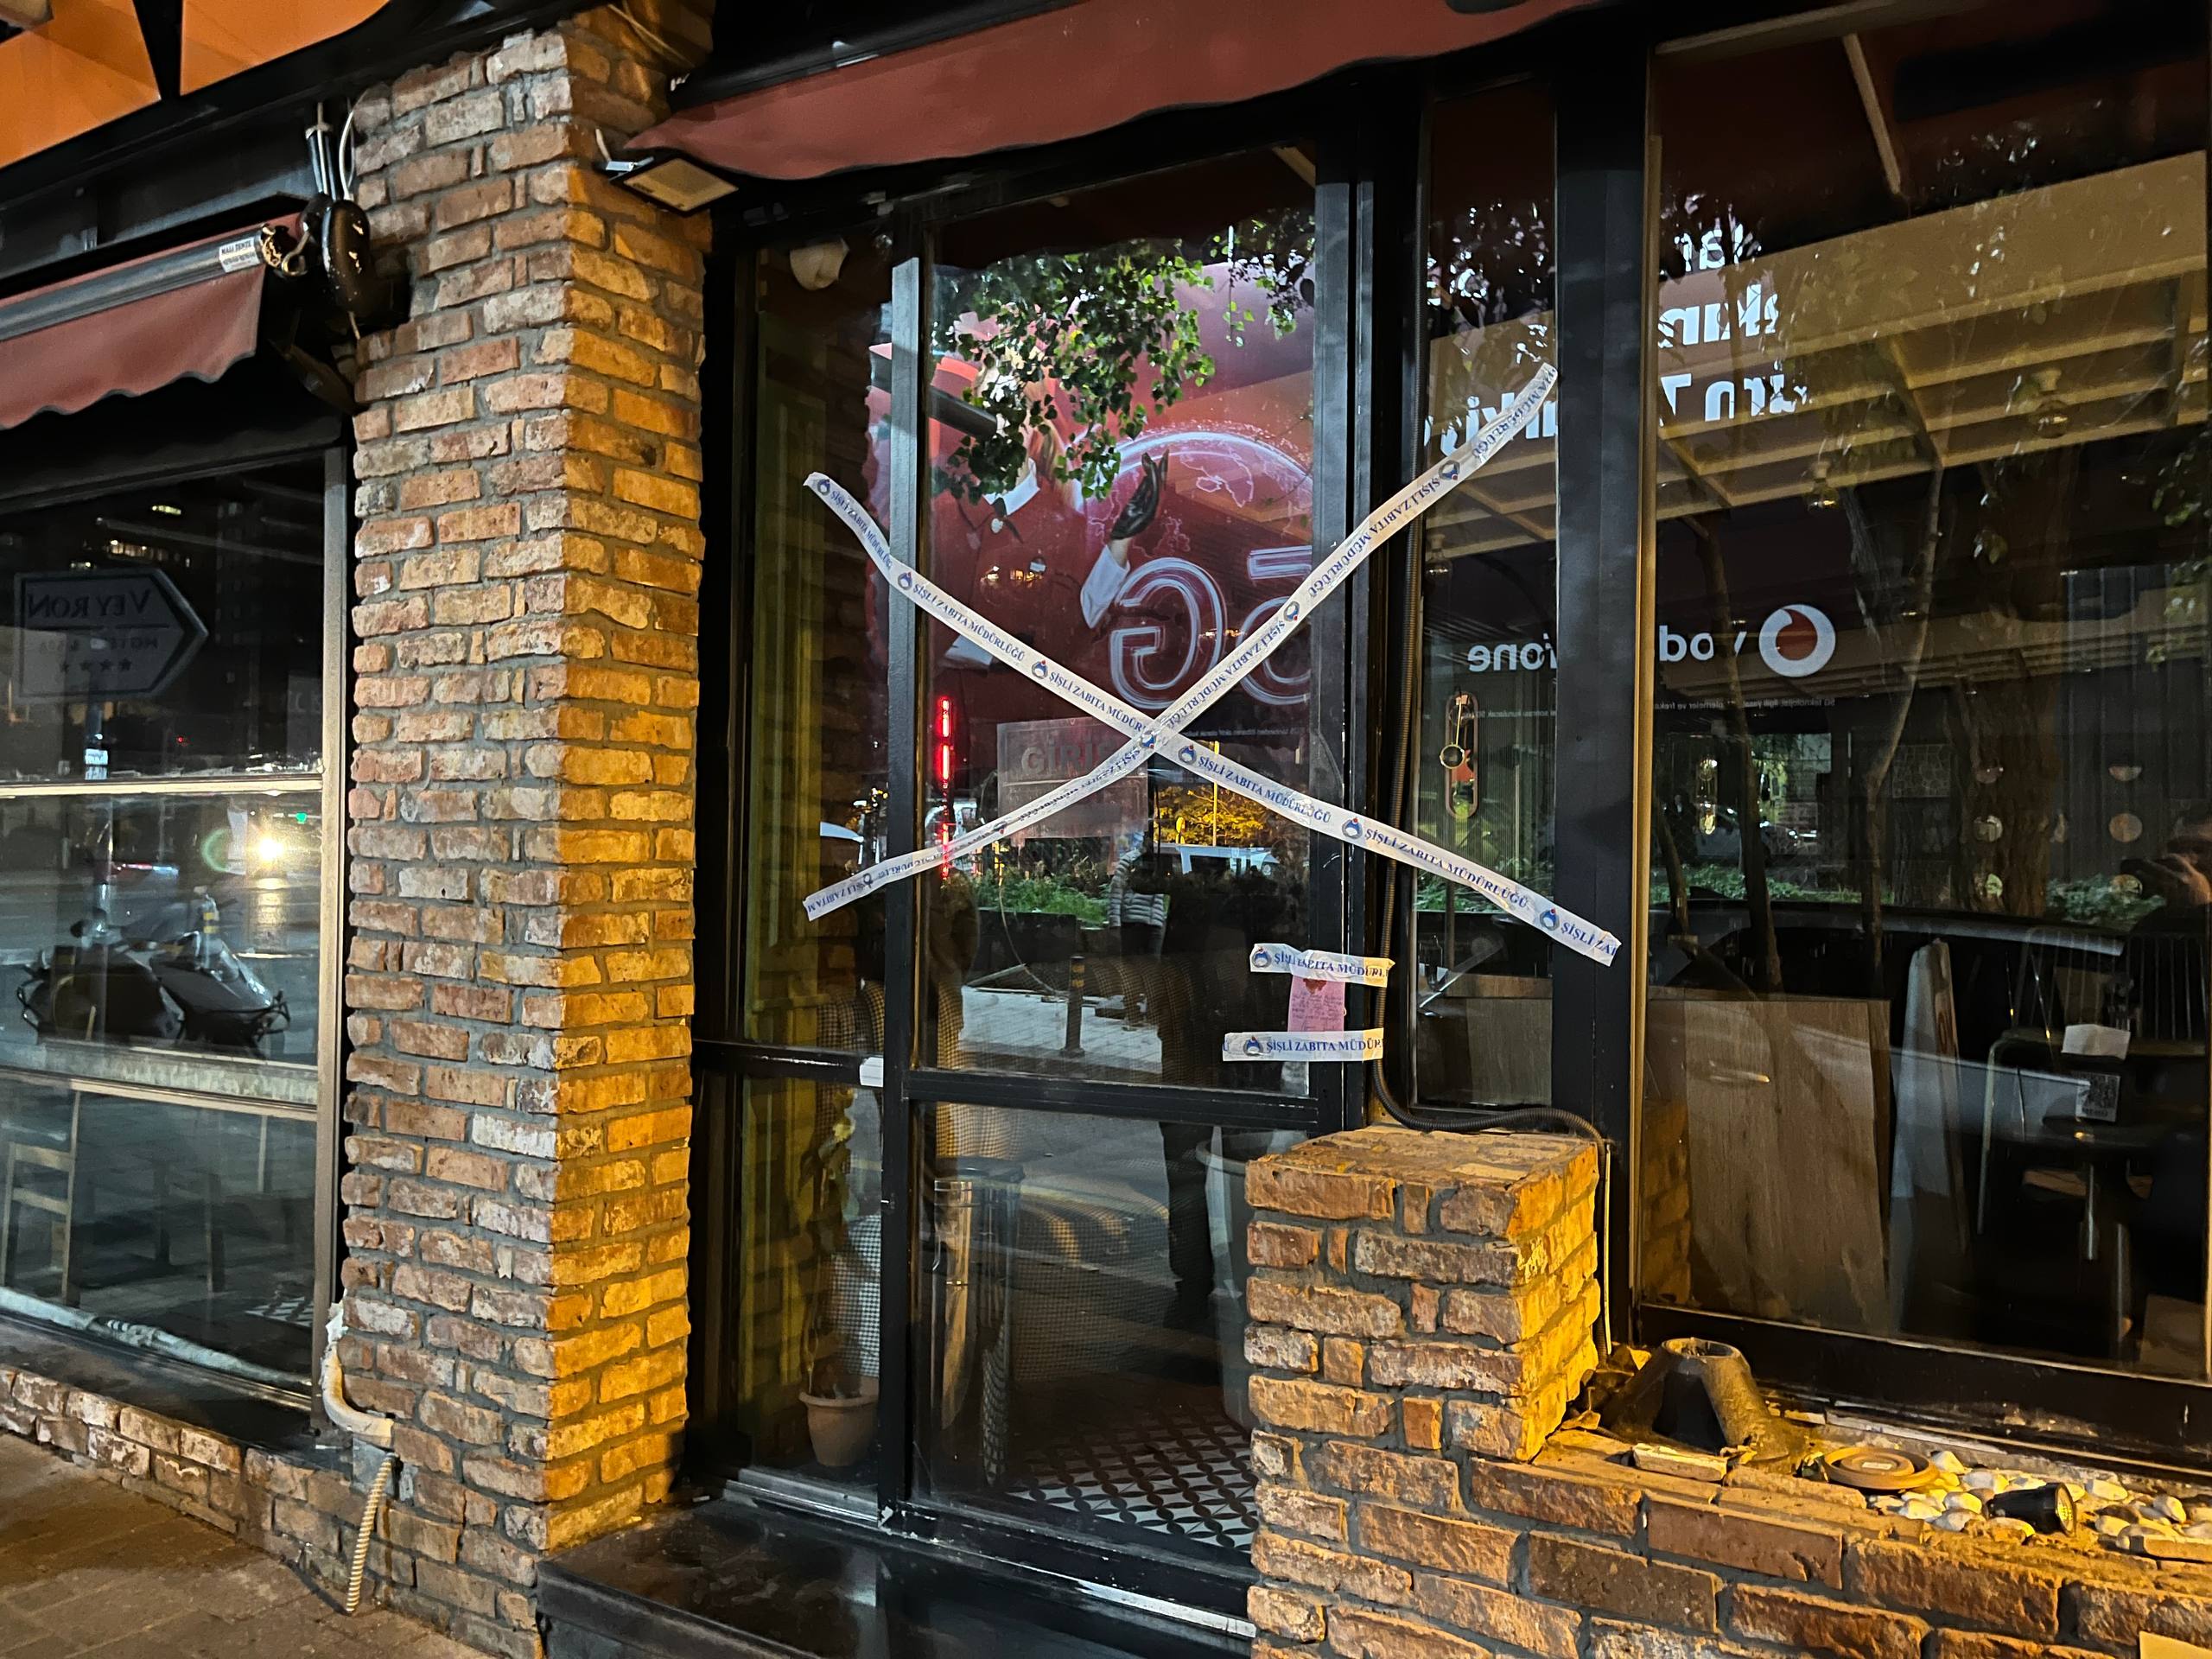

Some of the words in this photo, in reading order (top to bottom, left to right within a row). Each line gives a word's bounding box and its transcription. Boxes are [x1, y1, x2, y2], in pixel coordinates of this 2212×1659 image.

[1370, 500, 1412, 534] ZABITA
[1308, 532, 1371, 598] MÜDÜRLÜĞÜ
[913, 584, 938, 604] ŞİŞLİ
[936, 600, 968, 626] ZABITA
[968, 620, 1025, 662] MÜDÜRLÜĞÜ
[1224, 645, 1262, 676] ZABITA
[1049, 671, 1073, 691] ŞİŞLİ
[1072, 686, 1105, 711] ZABITA
[1107, 706, 1146, 732] MÜDÜR
[1198, 755, 1225, 775] ŞİŞLİ
[1225, 770, 1262, 796] ZABITA
[1265, 790, 1332, 823] MÜDÜRLÜĞÜ
[1364, 829, 1397, 848] ŞİŞLİ
[1398, 842, 1443, 868] ZABITA
[1446, 863, 1529, 908] MÜDÜRLÜĞÜ
[1560, 921, 1595, 945] ŞİŞLİ
[1266, 1039, 1293, 1053] ŞİŞLİ
[1295, 1041, 1337, 1052] ZABITA
[1339, 1039, 1382, 1051] MÜDÜR
